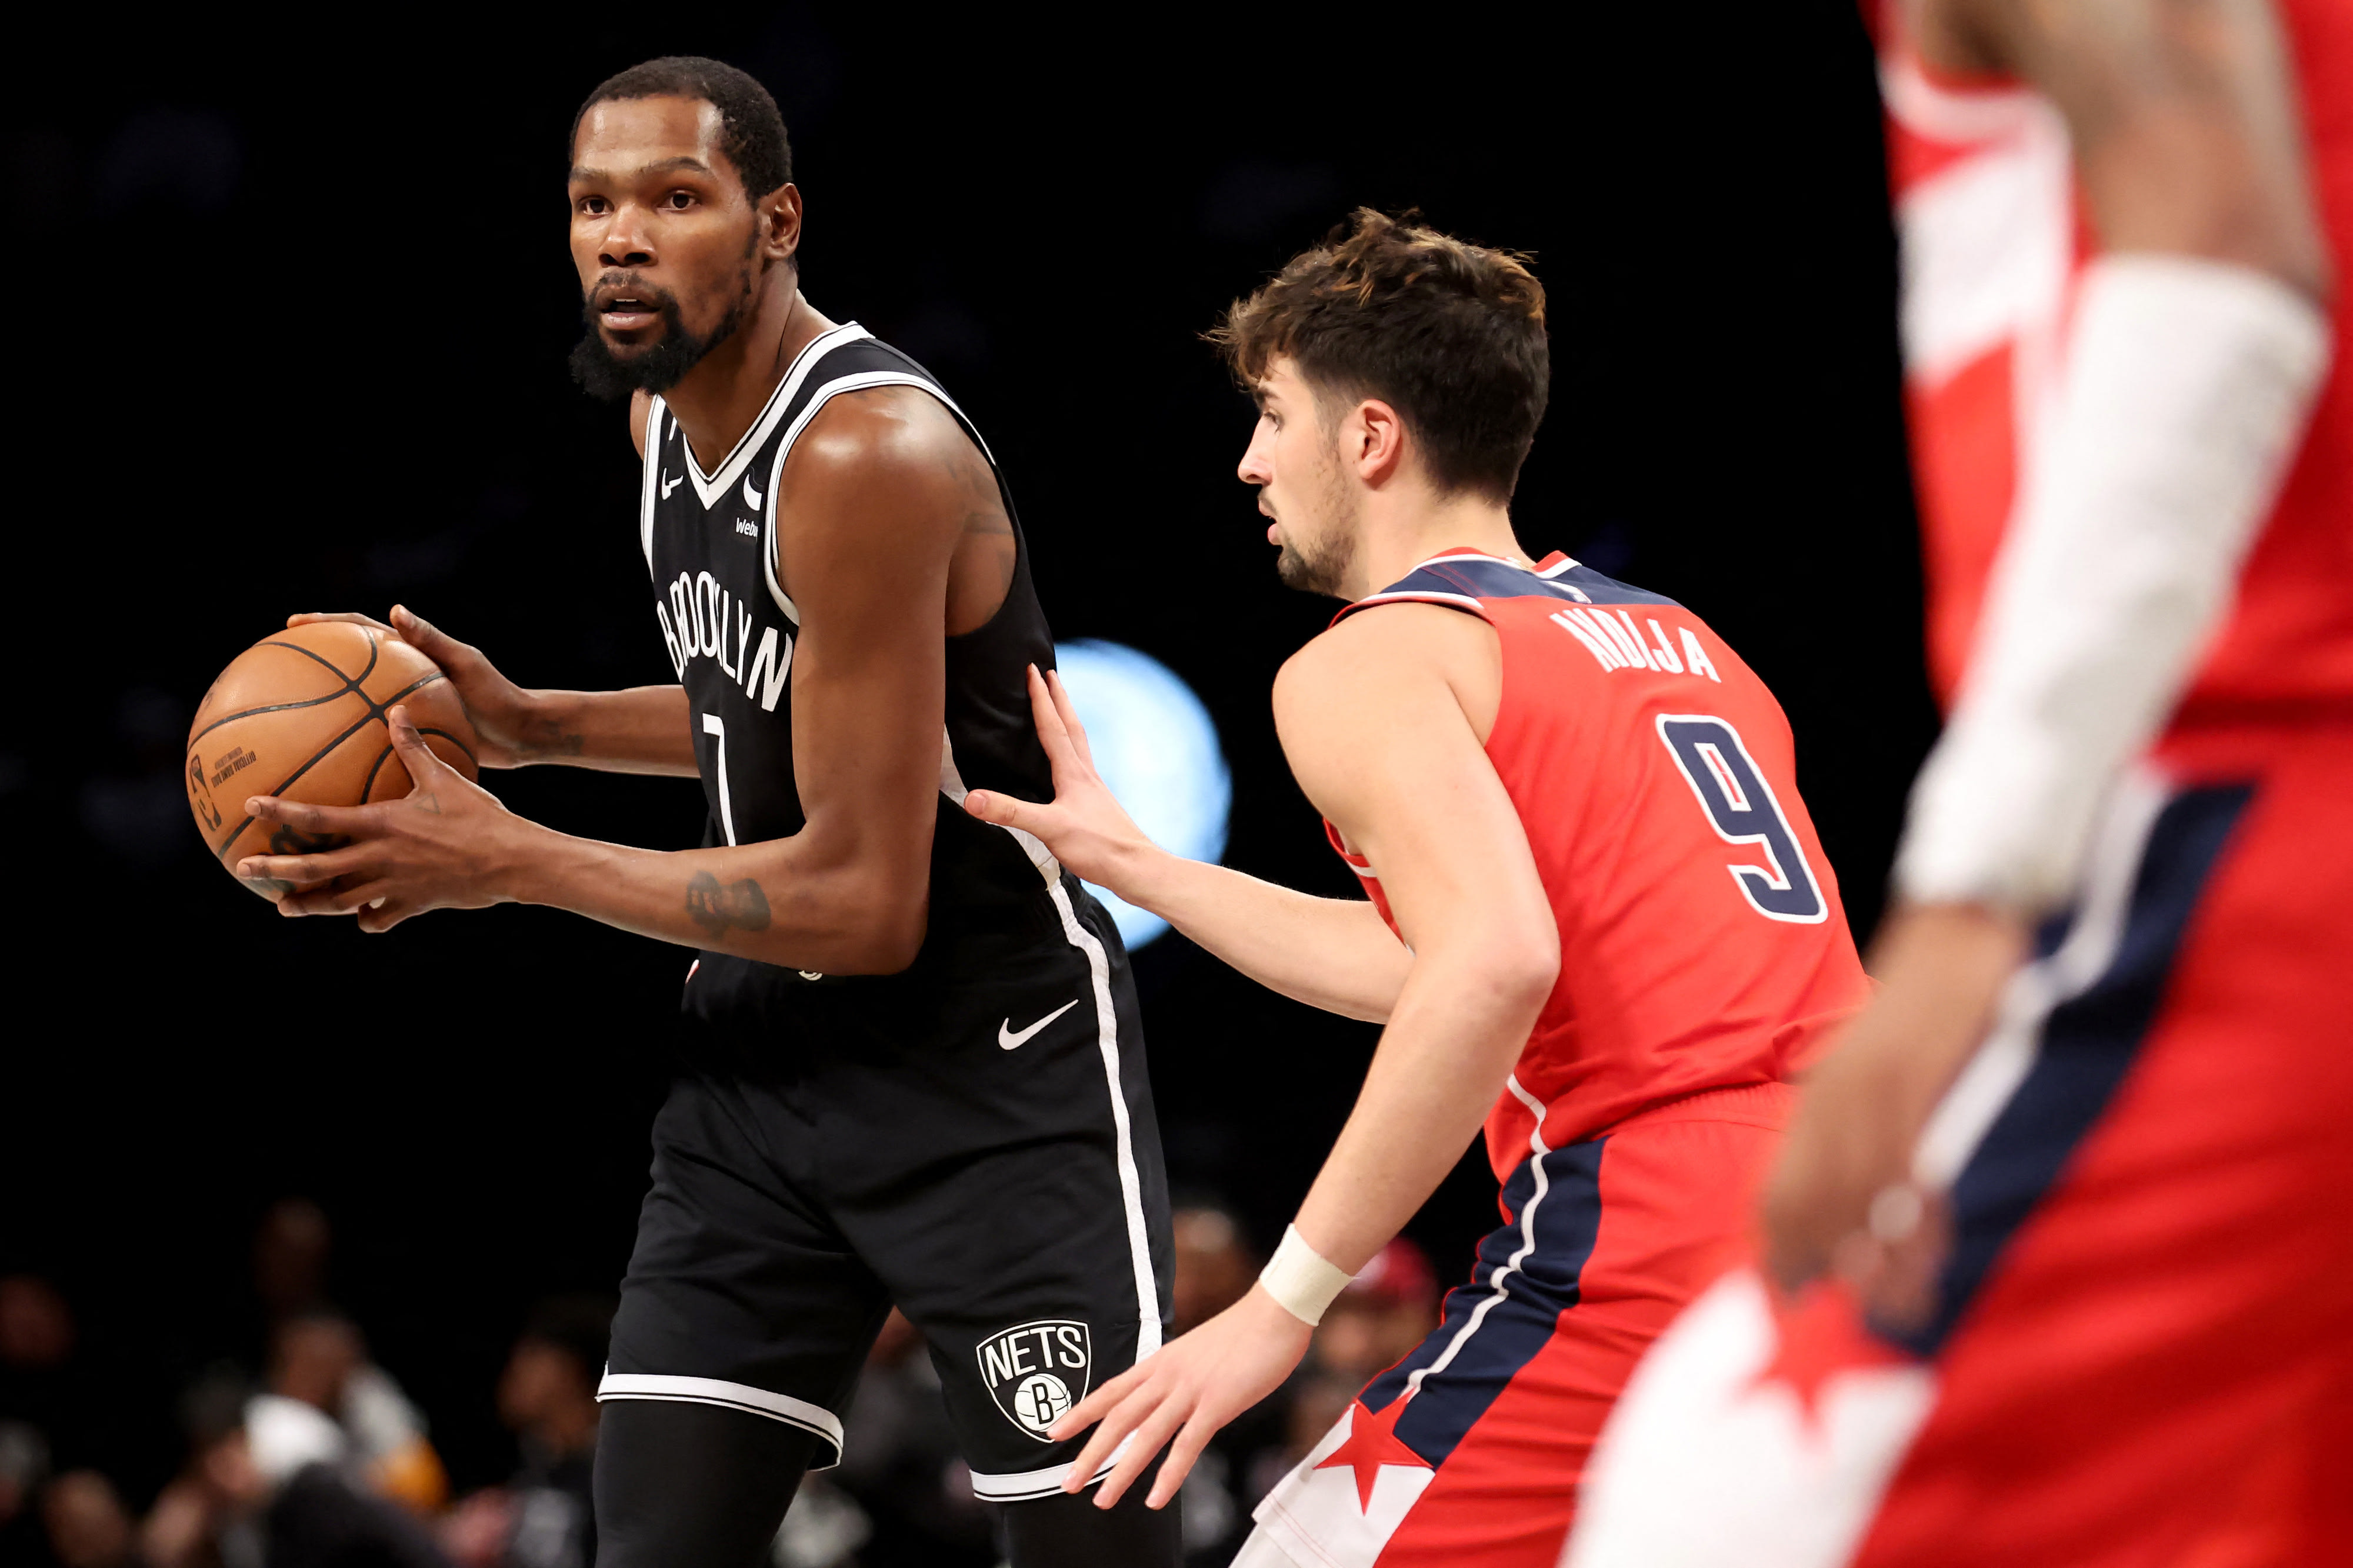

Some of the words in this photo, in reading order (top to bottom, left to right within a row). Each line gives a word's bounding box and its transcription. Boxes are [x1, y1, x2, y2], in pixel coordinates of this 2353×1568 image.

[735, 517, 759, 538] Webu
[702, 713, 736, 847] 7
[1655, 713, 1828, 924] 9
[985, 1326, 1086, 1389] NETS
[1031, 1382, 1054, 1424] B
